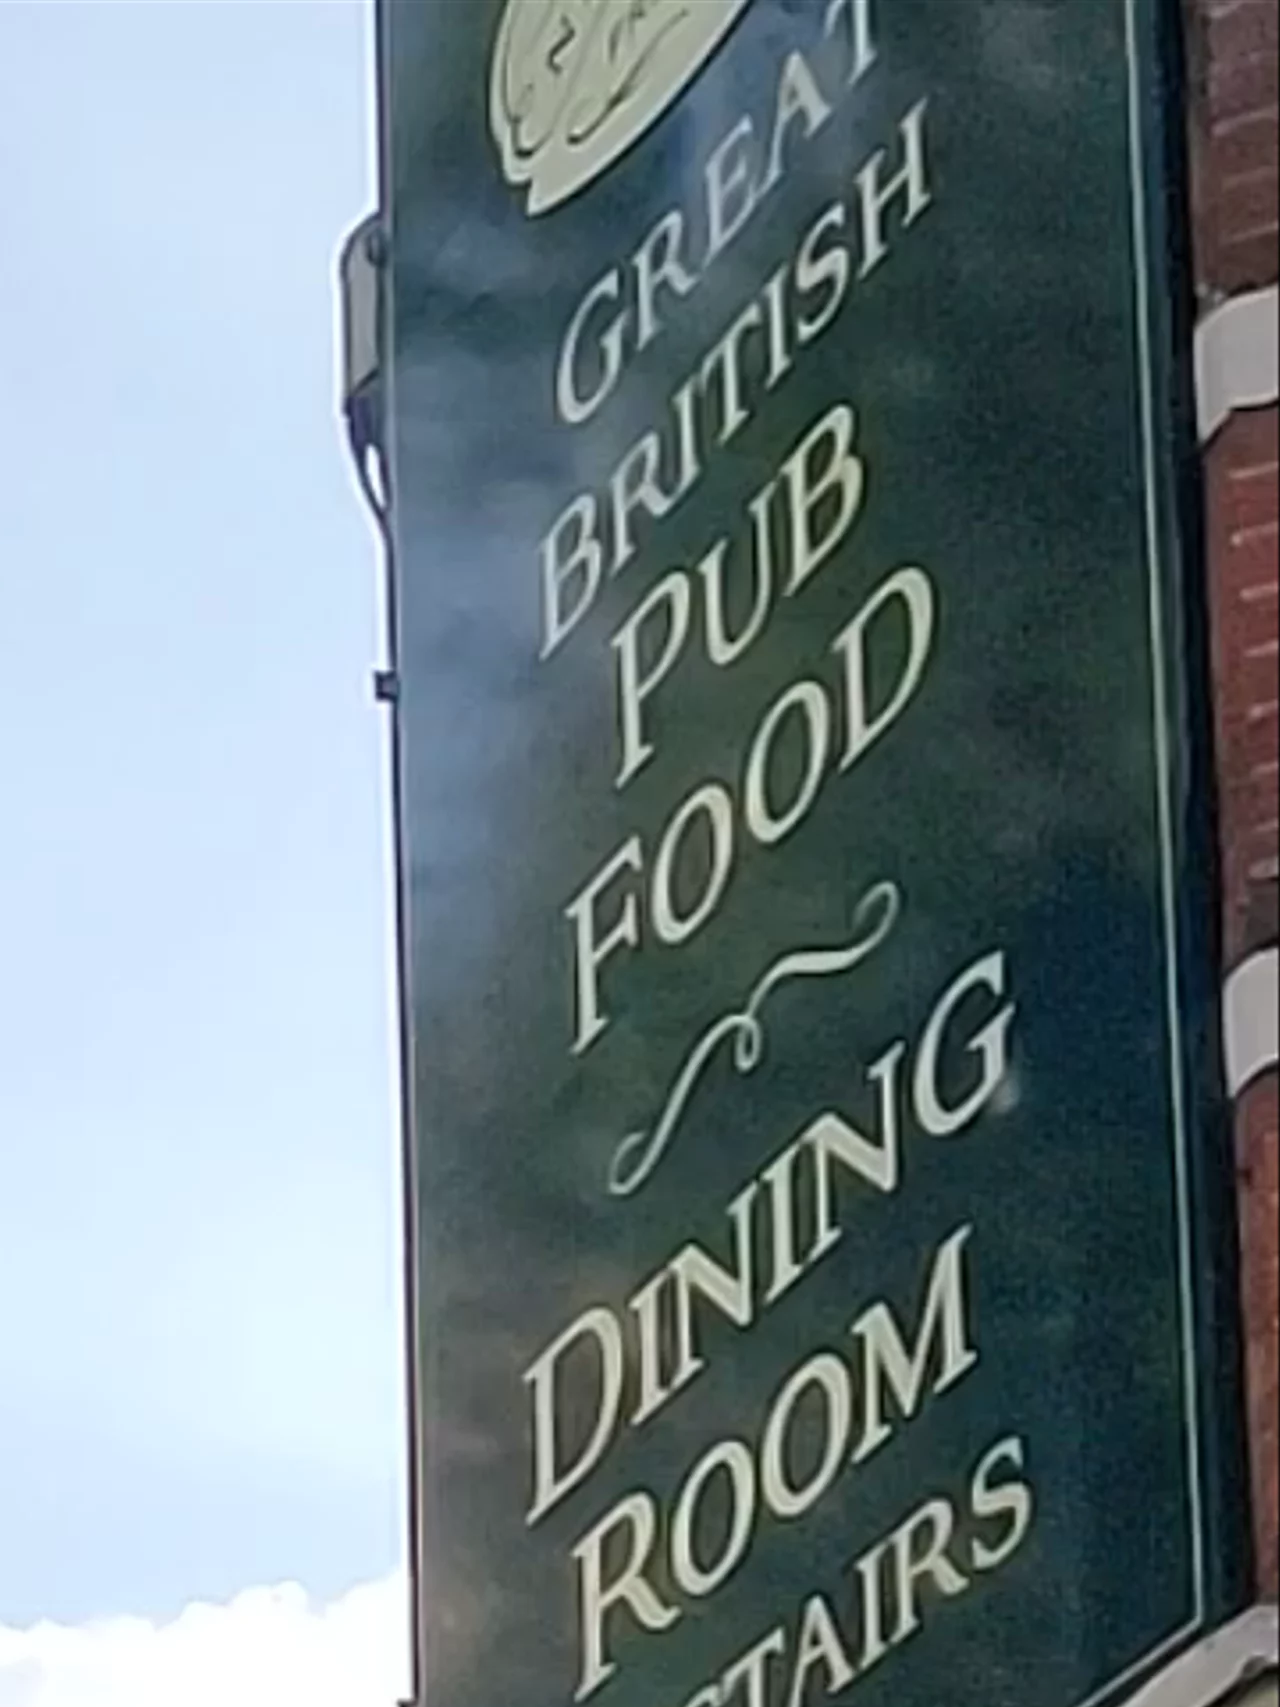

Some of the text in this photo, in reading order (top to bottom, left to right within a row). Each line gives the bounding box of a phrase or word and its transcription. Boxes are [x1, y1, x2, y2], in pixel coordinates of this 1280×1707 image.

[535, 98, 932, 661] BRITISH
[556, 0, 877, 424] GREAT
[564, 566, 934, 1056] FOOD
[610, 404, 865, 789] PUB
[522, 950, 1017, 1525] DINING
[570, 1224, 978, 1703] ROOM
